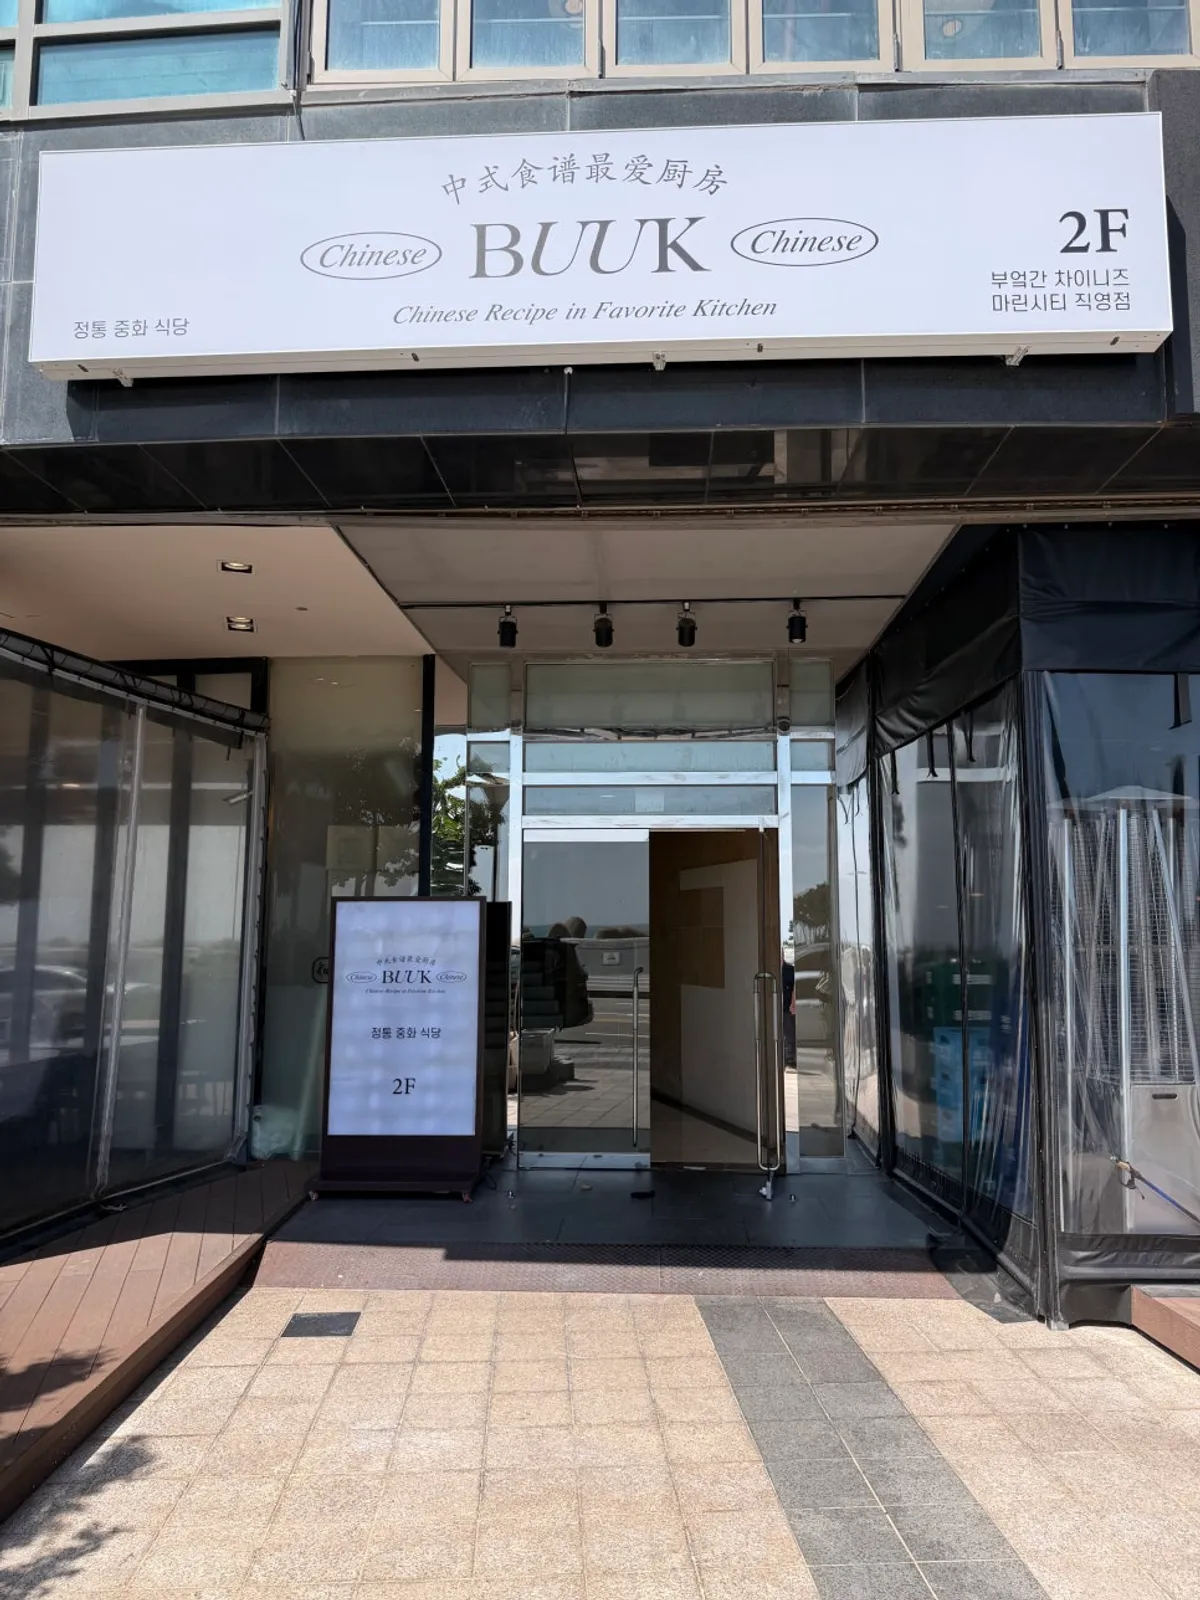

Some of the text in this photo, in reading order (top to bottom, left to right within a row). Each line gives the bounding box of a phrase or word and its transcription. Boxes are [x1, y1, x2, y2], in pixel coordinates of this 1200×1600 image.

[441, 152, 728, 206] 中式食谱最爱厨房
[750, 228, 863, 255] Chinese
[1058, 208, 1130, 254] 2F
[318, 242, 428, 269] Chinese
[468, 215, 712, 279] BUUK
[991, 268, 1131, 290] 부엌간 차이니즈
[393, 298, 778, 326] Chinese Recipe in Favorite Kitchen
[992, 291, 1131, 313] 마린시티 직영점
[73, 317, 190, 340] 정통 중화 식당
[381, 970, 433, 984] BUUK
[371, 1027, 442, 1039] 정통 중화 식당
[391, 1077, 416, 1095] 2F
